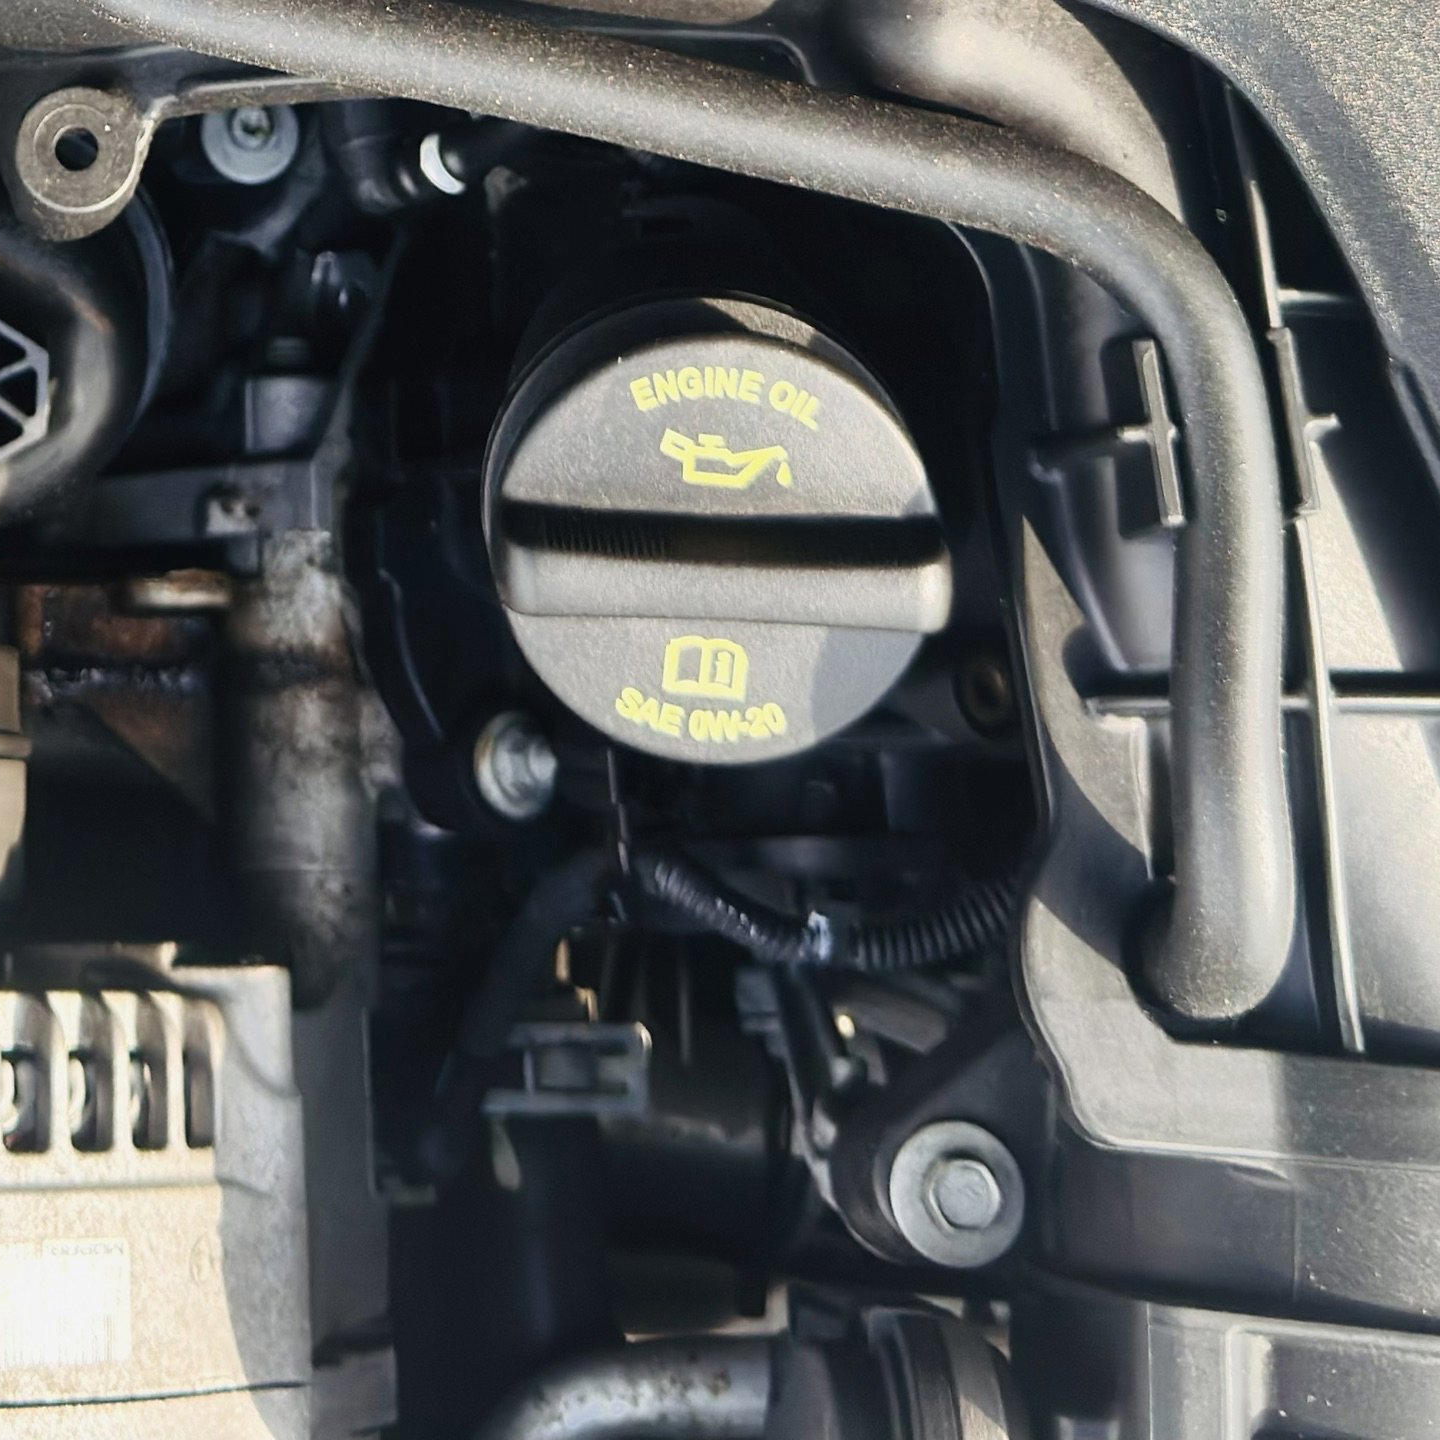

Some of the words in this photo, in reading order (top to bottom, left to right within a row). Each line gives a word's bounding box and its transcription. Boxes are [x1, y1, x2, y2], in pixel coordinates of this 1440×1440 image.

[629, 366, 766, 412] ENGINE
[768, 380, 821, 432] OIL
[615, 687, 687, 739] SAE
[687, 701, 788, 744] 0W-20
